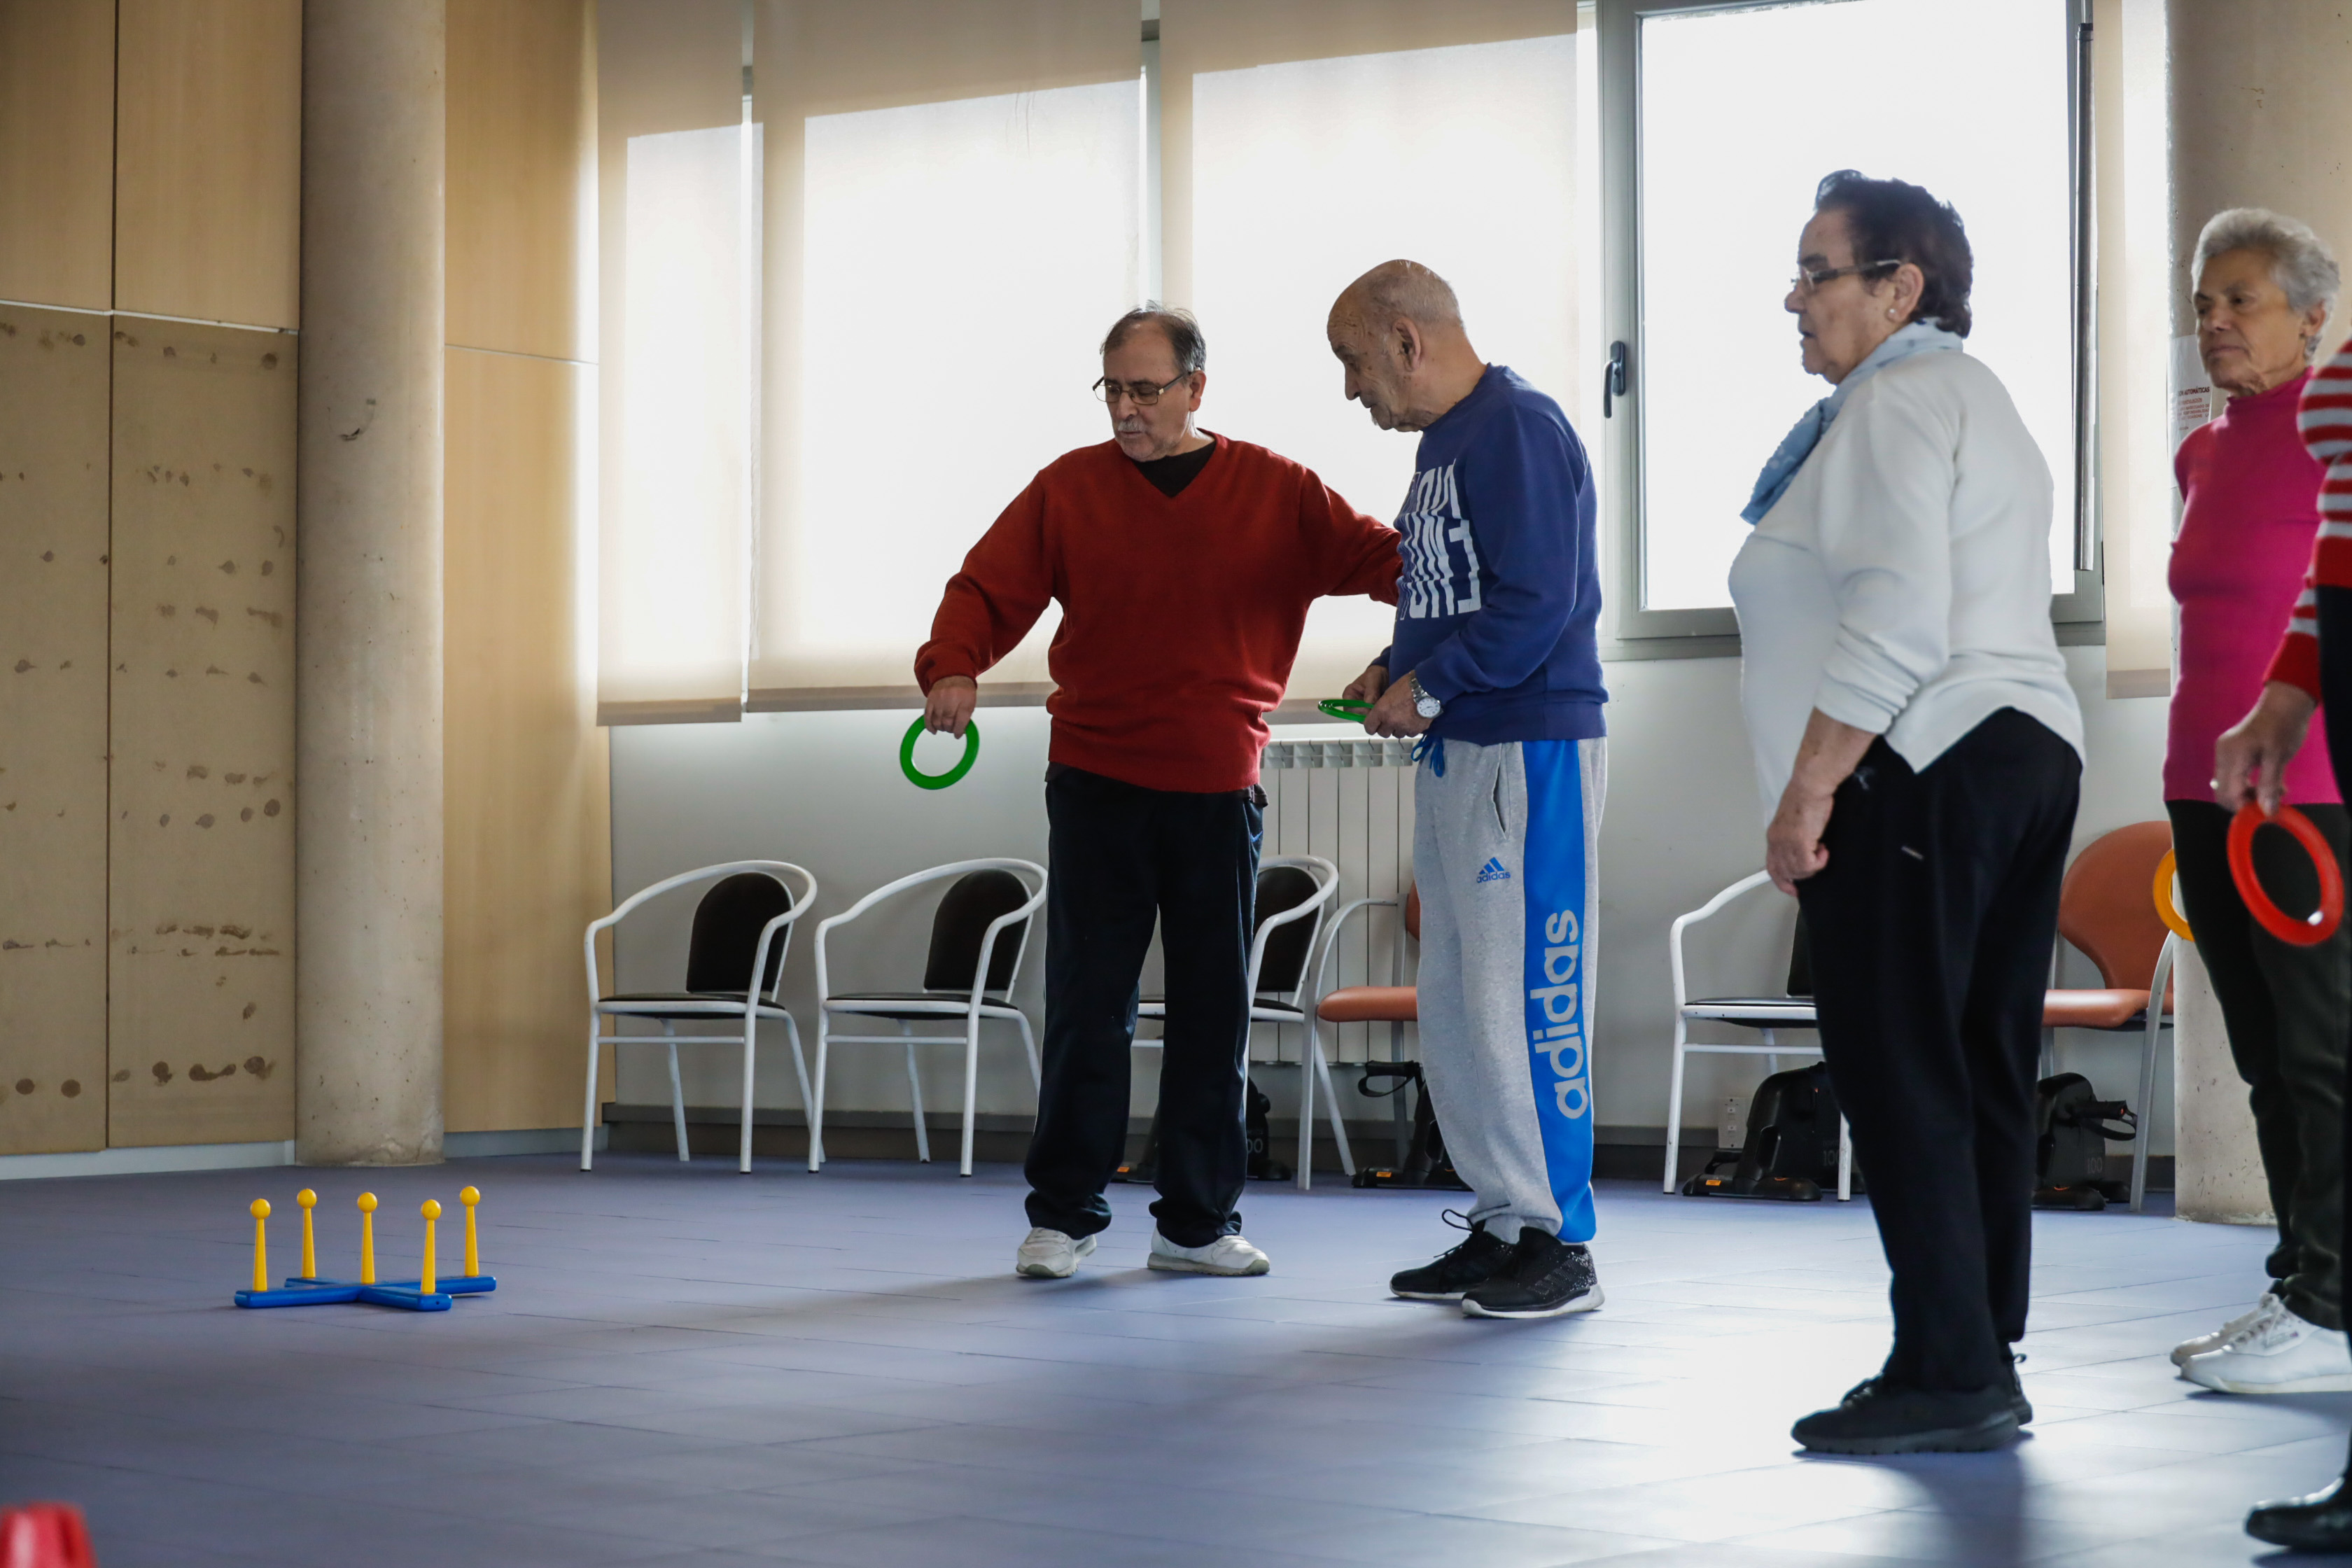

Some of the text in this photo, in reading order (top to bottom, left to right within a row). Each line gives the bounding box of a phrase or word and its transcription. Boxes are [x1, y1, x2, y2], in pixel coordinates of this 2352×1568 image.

[1476, 872, 1511, 883] adidas
[1530, 909, 1588, 1119] adidas
[2087, 1156, 2103, 1174] 100
